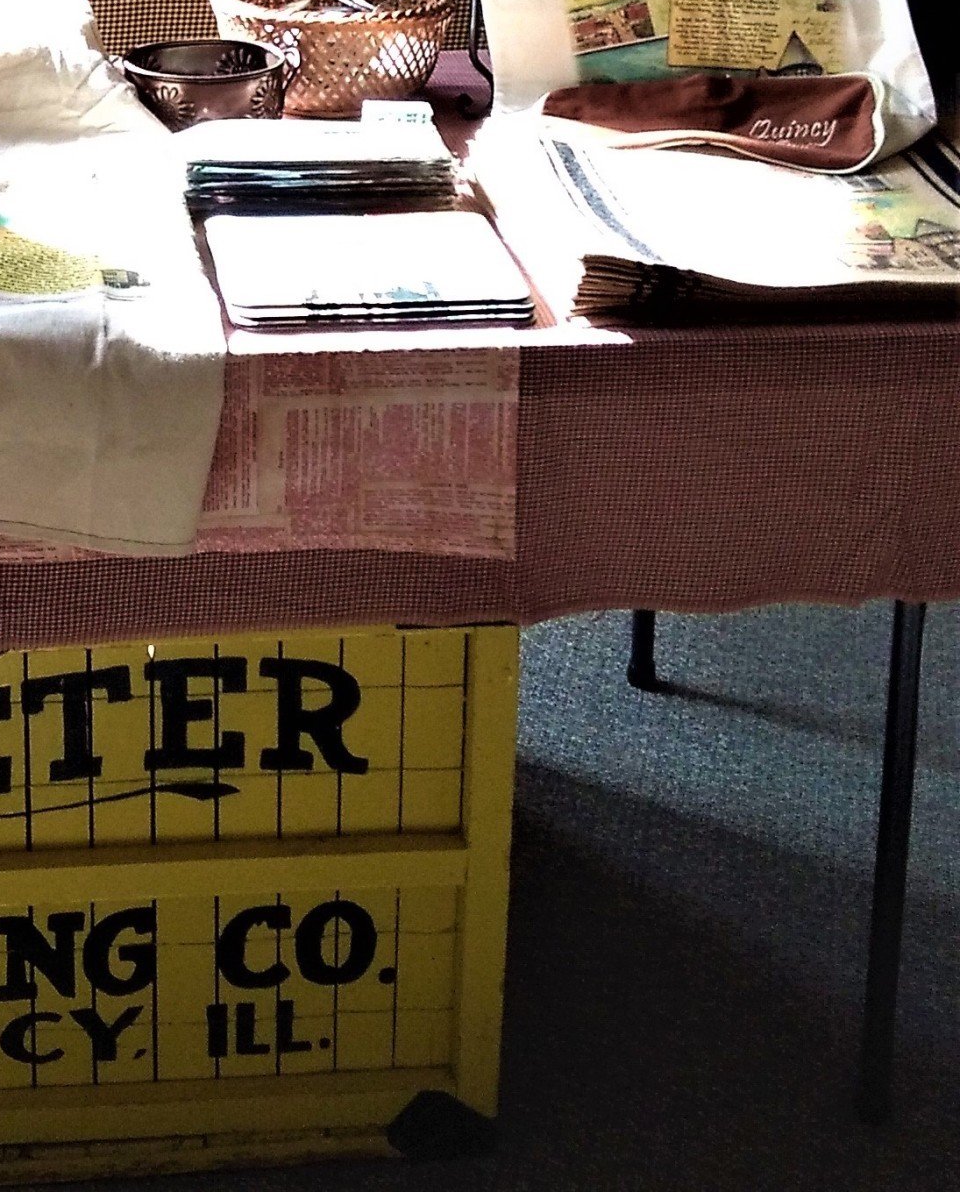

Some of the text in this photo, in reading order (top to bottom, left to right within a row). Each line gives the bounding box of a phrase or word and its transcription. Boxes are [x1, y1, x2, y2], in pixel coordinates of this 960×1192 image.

[749, 118, 839, 147] Quincy
[214, 899, 398, 990] CO.
[205, 998, 332, 1059] ILL.
